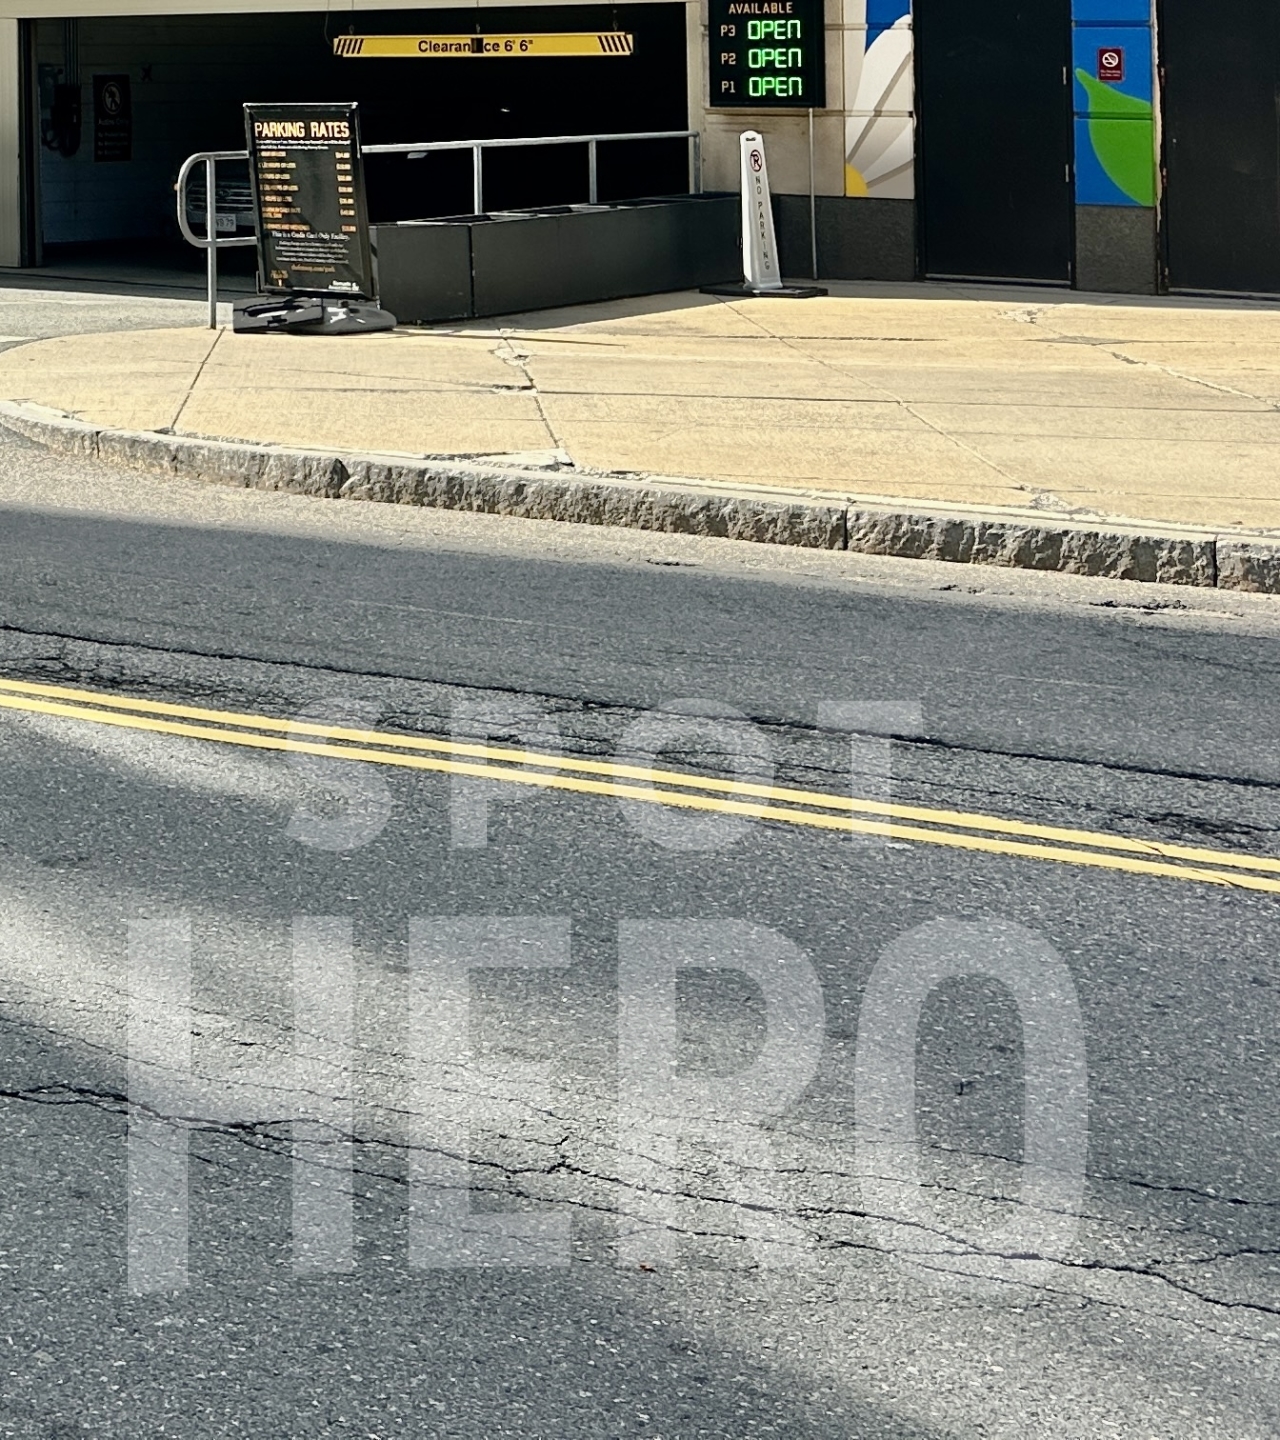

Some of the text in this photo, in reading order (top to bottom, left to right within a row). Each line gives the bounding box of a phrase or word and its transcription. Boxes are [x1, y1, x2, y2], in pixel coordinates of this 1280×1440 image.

[729, 2, 793, 14] AVAILABLE
[720, 20, 801, 40] P3 OPEN
[418, 40, 500, 52] Clearance
[721, 48, 802, 68] P2 OPEN
[721, 77, 802, 96] P1 OPEN
[254, 121, 350, 138] PARKING RATES
[755, 176, 770, 270] NO PARKING
